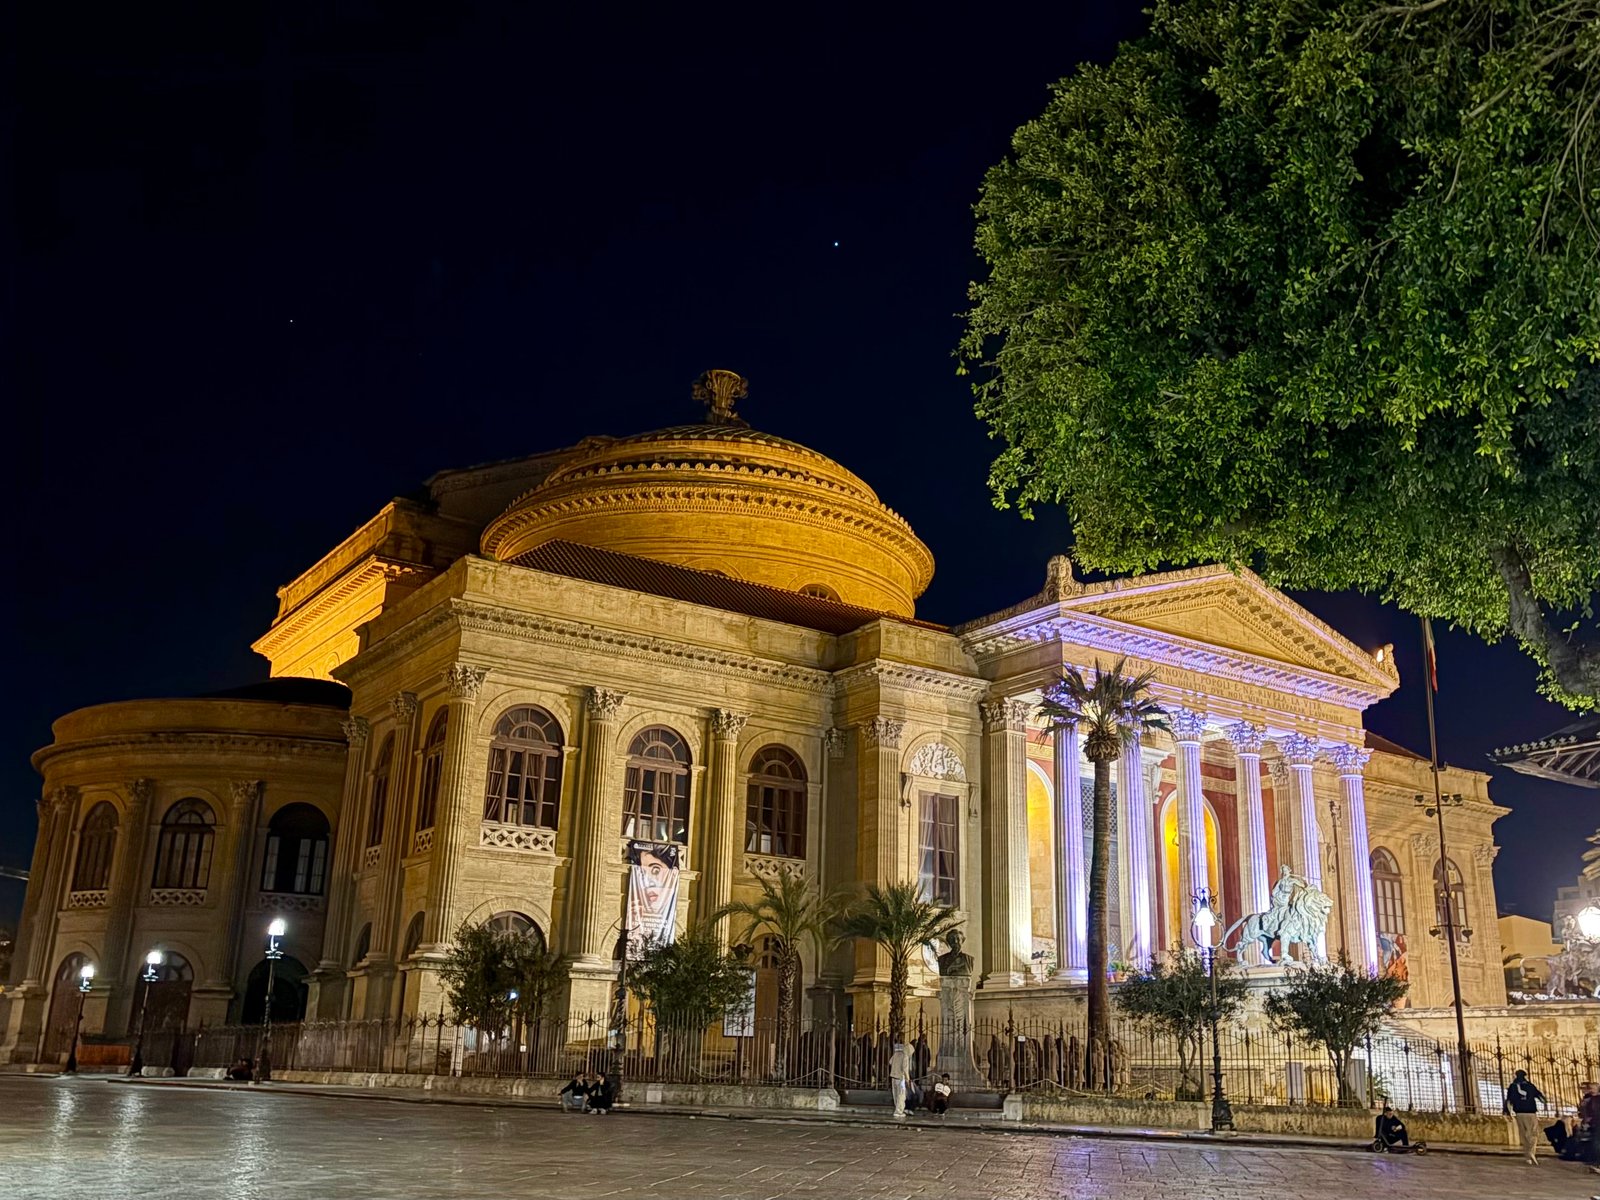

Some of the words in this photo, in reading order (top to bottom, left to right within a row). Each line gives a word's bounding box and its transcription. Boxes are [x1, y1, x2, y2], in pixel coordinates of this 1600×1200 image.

[1201, 675, 1232, 690] POPOLI
[1243, 685, 1253, 696] NE
[1258, 689, 1287, 704] RIVELA
[1291, 695, 1301, 705] LA
[1303, 699, 1322, 711] VITA
